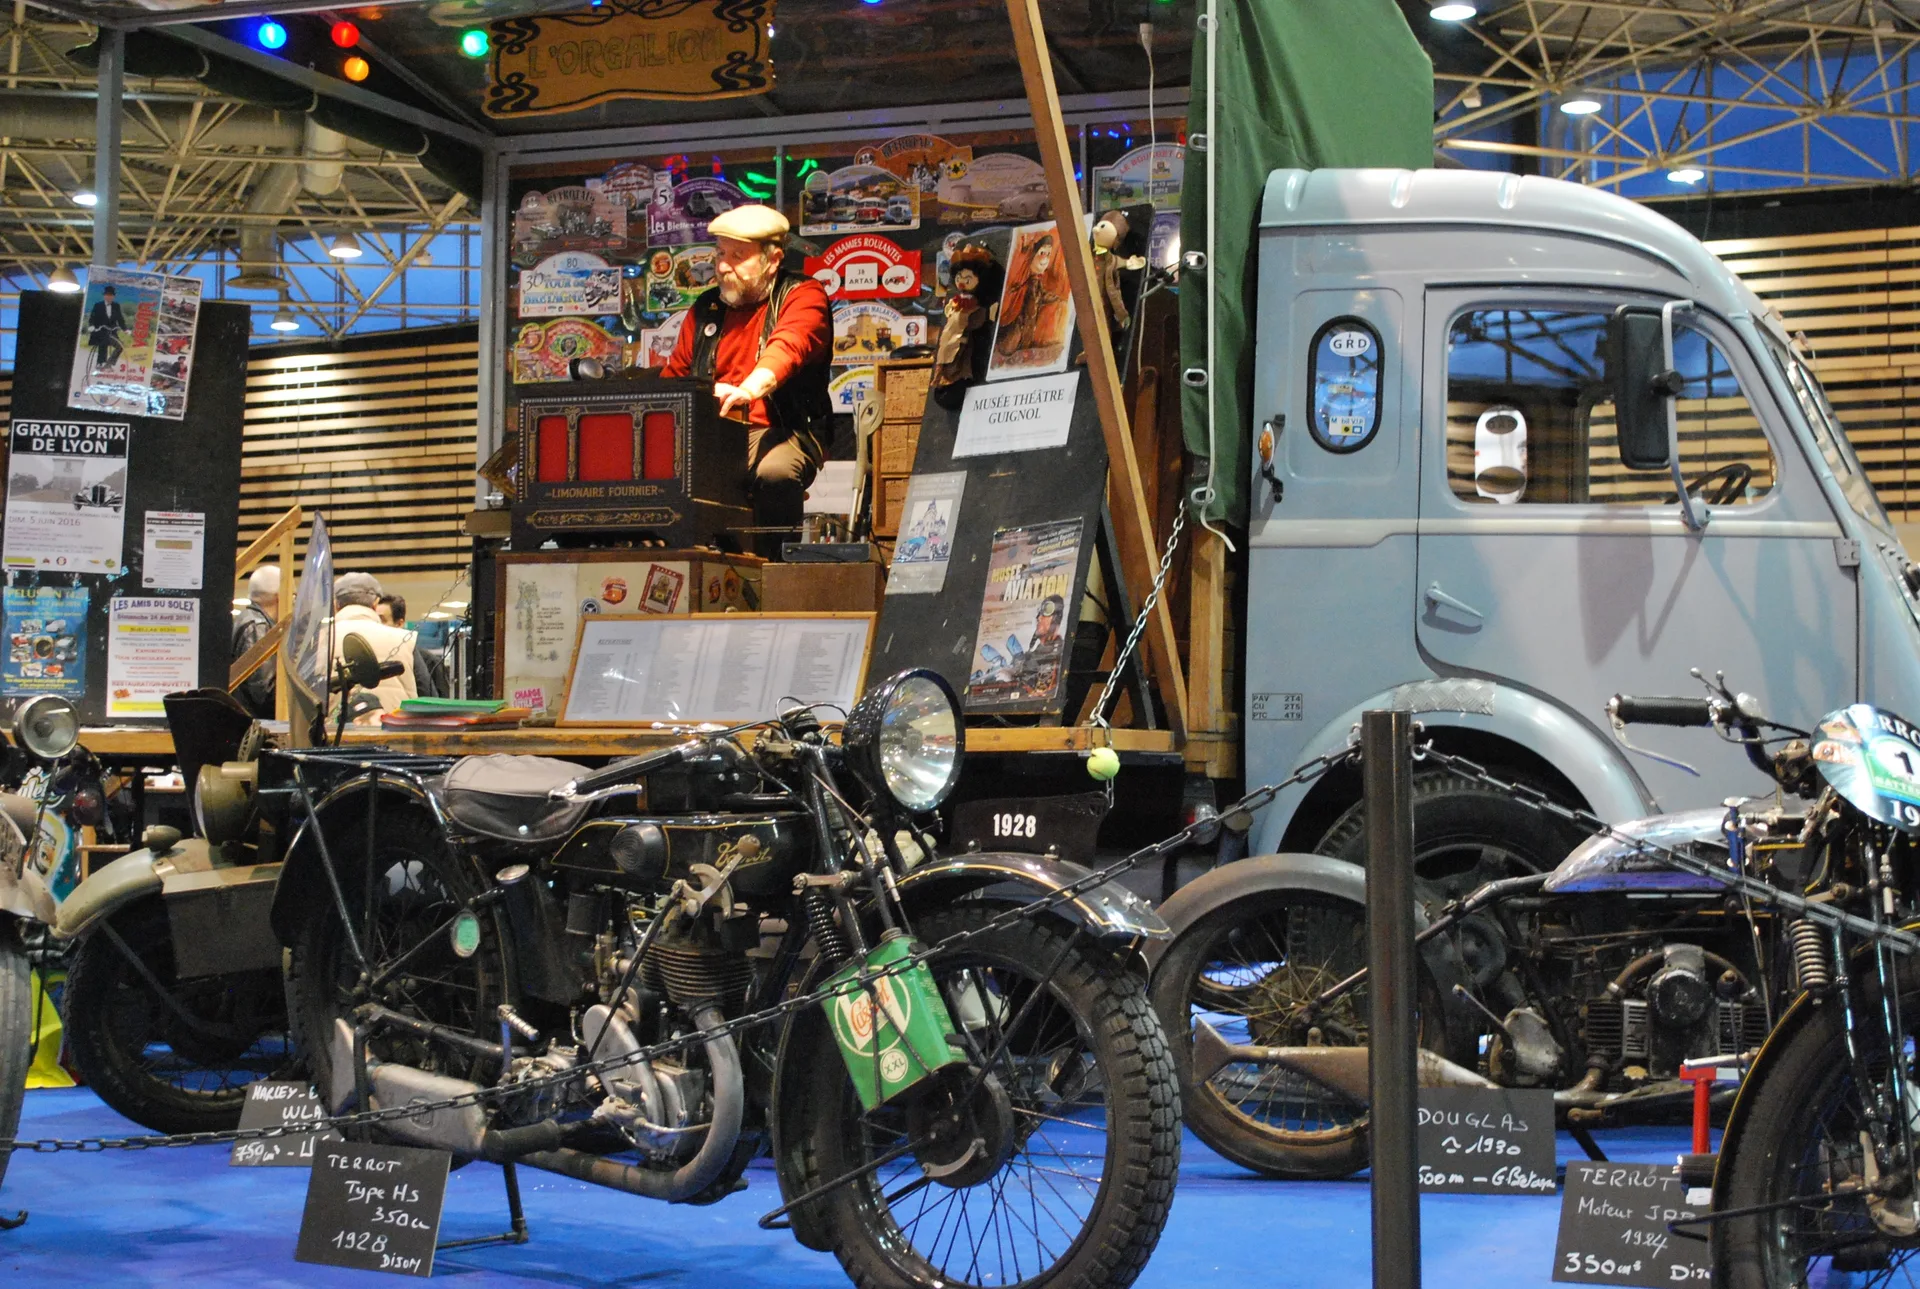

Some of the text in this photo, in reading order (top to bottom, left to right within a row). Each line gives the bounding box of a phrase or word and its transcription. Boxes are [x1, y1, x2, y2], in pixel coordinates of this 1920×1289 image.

[528, 28, 722, 78] L'ORGALION
[823, 238, 902, 266] LES MAMIES ROULANTES
[566, 257, 578, 268] 80
[544, 279, 571, 289] TOUR
[848, 277, 874, 285] ARTAS
[973, 387, 1065, 411] MUSÉE THÉÂTRE
[988, 407, 1041, 425] GUIGNOL
[15, 423, 126, 440] GRAND PRIX
[32, 438, 108, 454] DE LYON
[551, 485, 658, 498] LIMONAIRE FOURNIER
[30, 515, 36, 524] 5
[57, 517, 81, 527] 2016
[1003, 573, 1070, 602] AVIATION
[113, 600, 194, 613] LES AMIS DU SOLEX
[1252, 711, 1268, 719] PTC
[992, 813, 1037, 838] 1928
[883, 1058, 906, 1076] XXL
[282, 1104, 322, 1120] WLA
[1417, 1107, 1530, 1133] DOUGLAS
[1464, 1135, 1522, 1156] 1930
[327, 1153, 401, 1173] TERROT
[1580, 1167, 1682, 1192] TERROT
[344, 1180, 385, 1204] Type
[1577, 1196, 1634, 1219] Moteur
[331, 1230, 389, 1253] 1928
[1620, 1228, 1669, 1259] 1924
